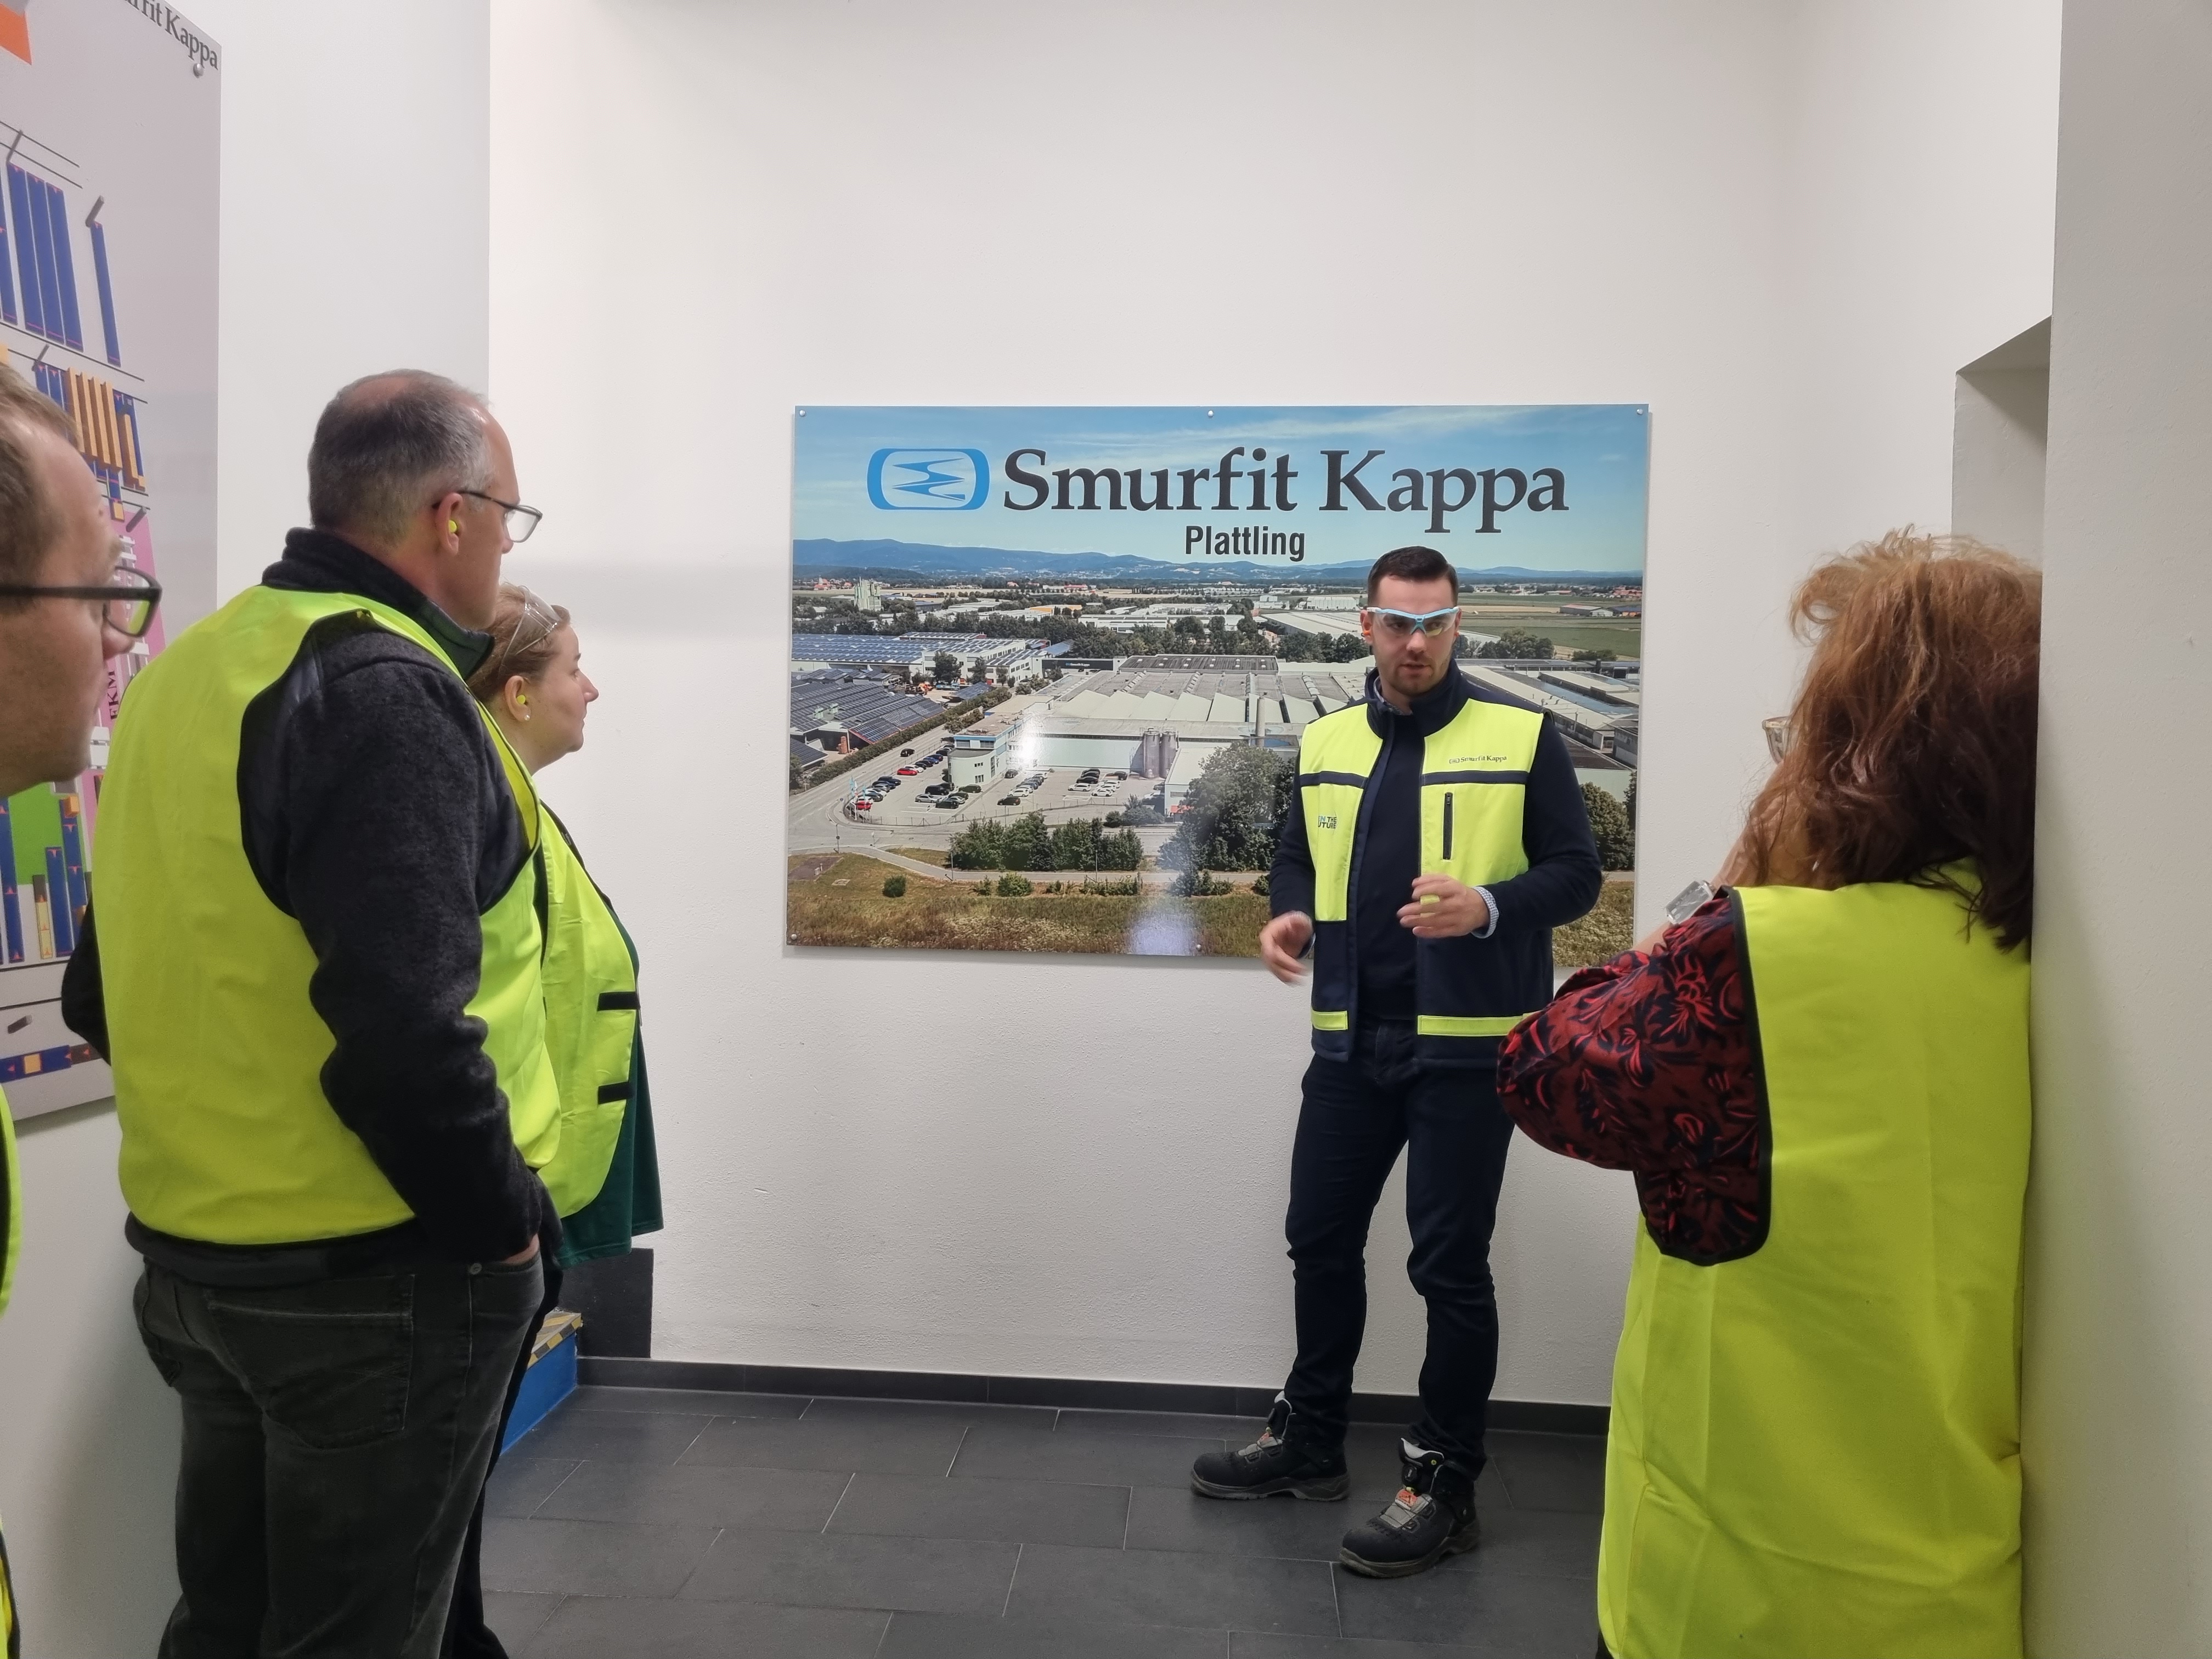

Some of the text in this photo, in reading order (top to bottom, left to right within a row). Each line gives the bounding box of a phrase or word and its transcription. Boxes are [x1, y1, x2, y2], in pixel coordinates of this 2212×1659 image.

[165, 6, 218, 70] Kappa
[1003, 446, 1570, 533] Smurfit Kappa
[1185, 525, 1305, 562] Plattling
